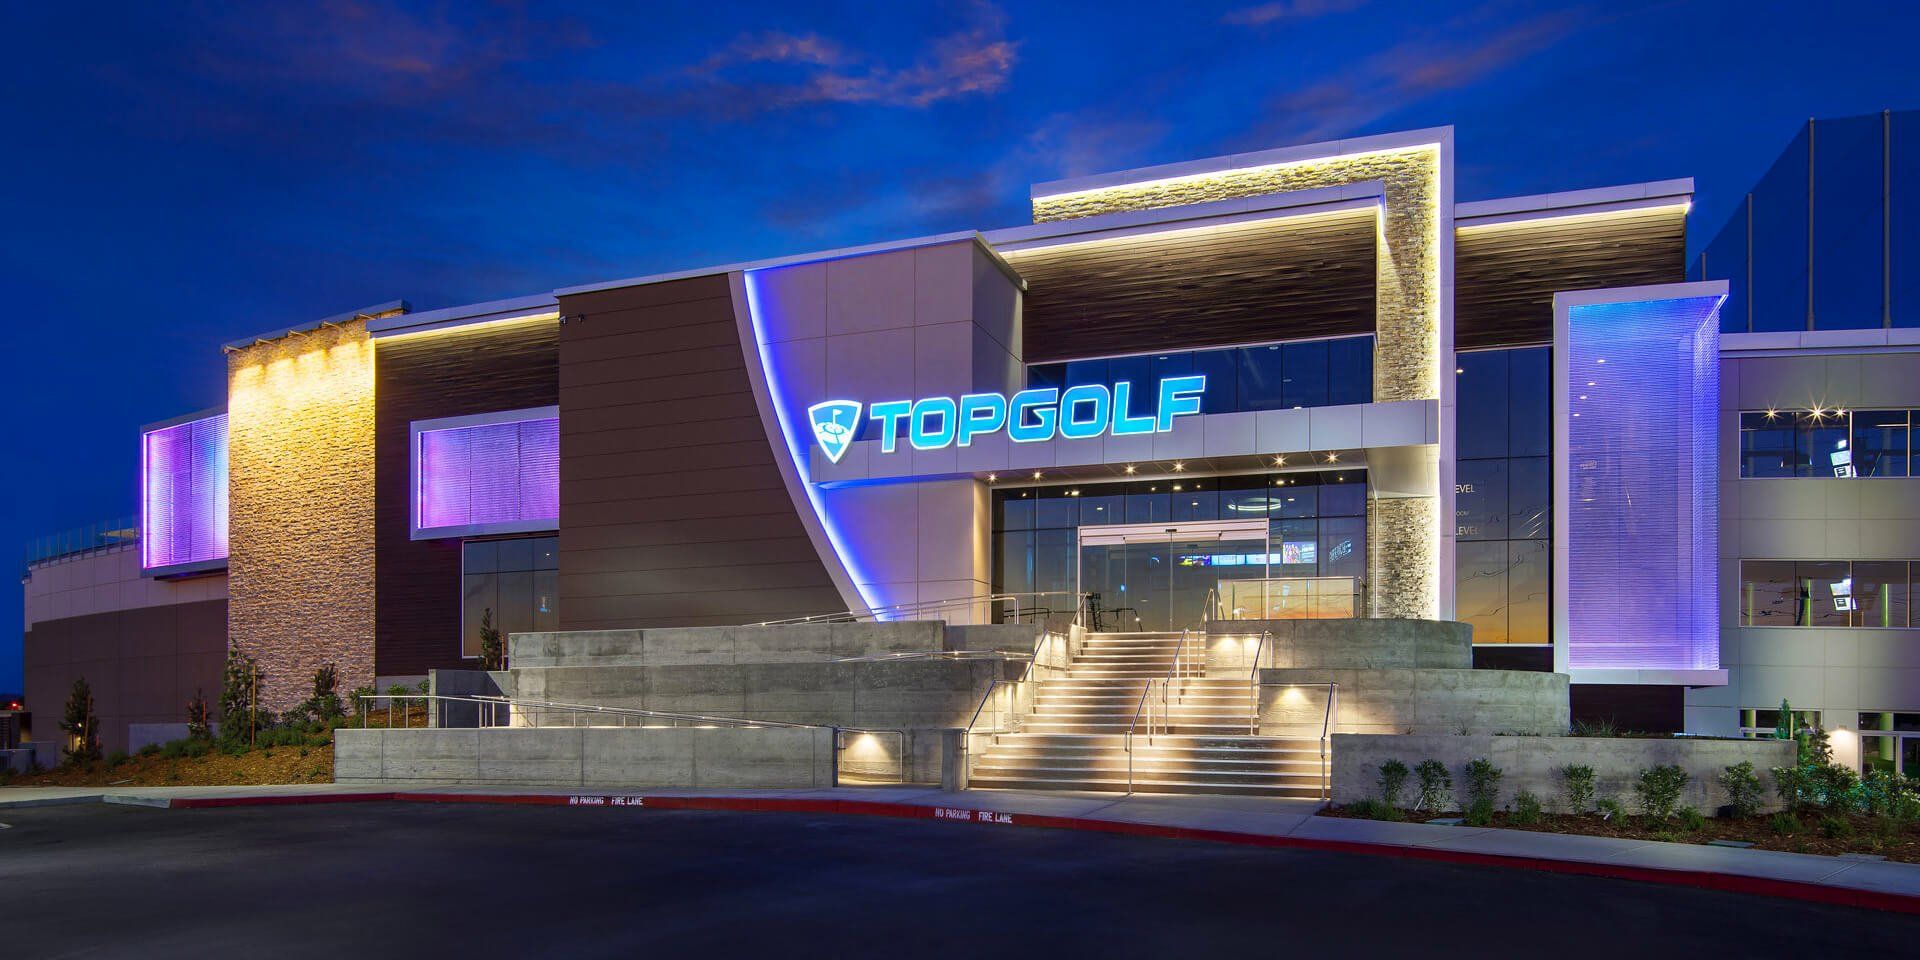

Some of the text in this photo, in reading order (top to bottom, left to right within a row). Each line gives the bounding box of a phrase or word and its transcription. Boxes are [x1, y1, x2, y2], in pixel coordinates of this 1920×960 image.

[869, 375, 1206, 453] TOPGOLF
[569, 796, 643, 806] NO PARKING FIRE LANE
[935, 808, 1013, 824] NO PARKING FIRE LANE
